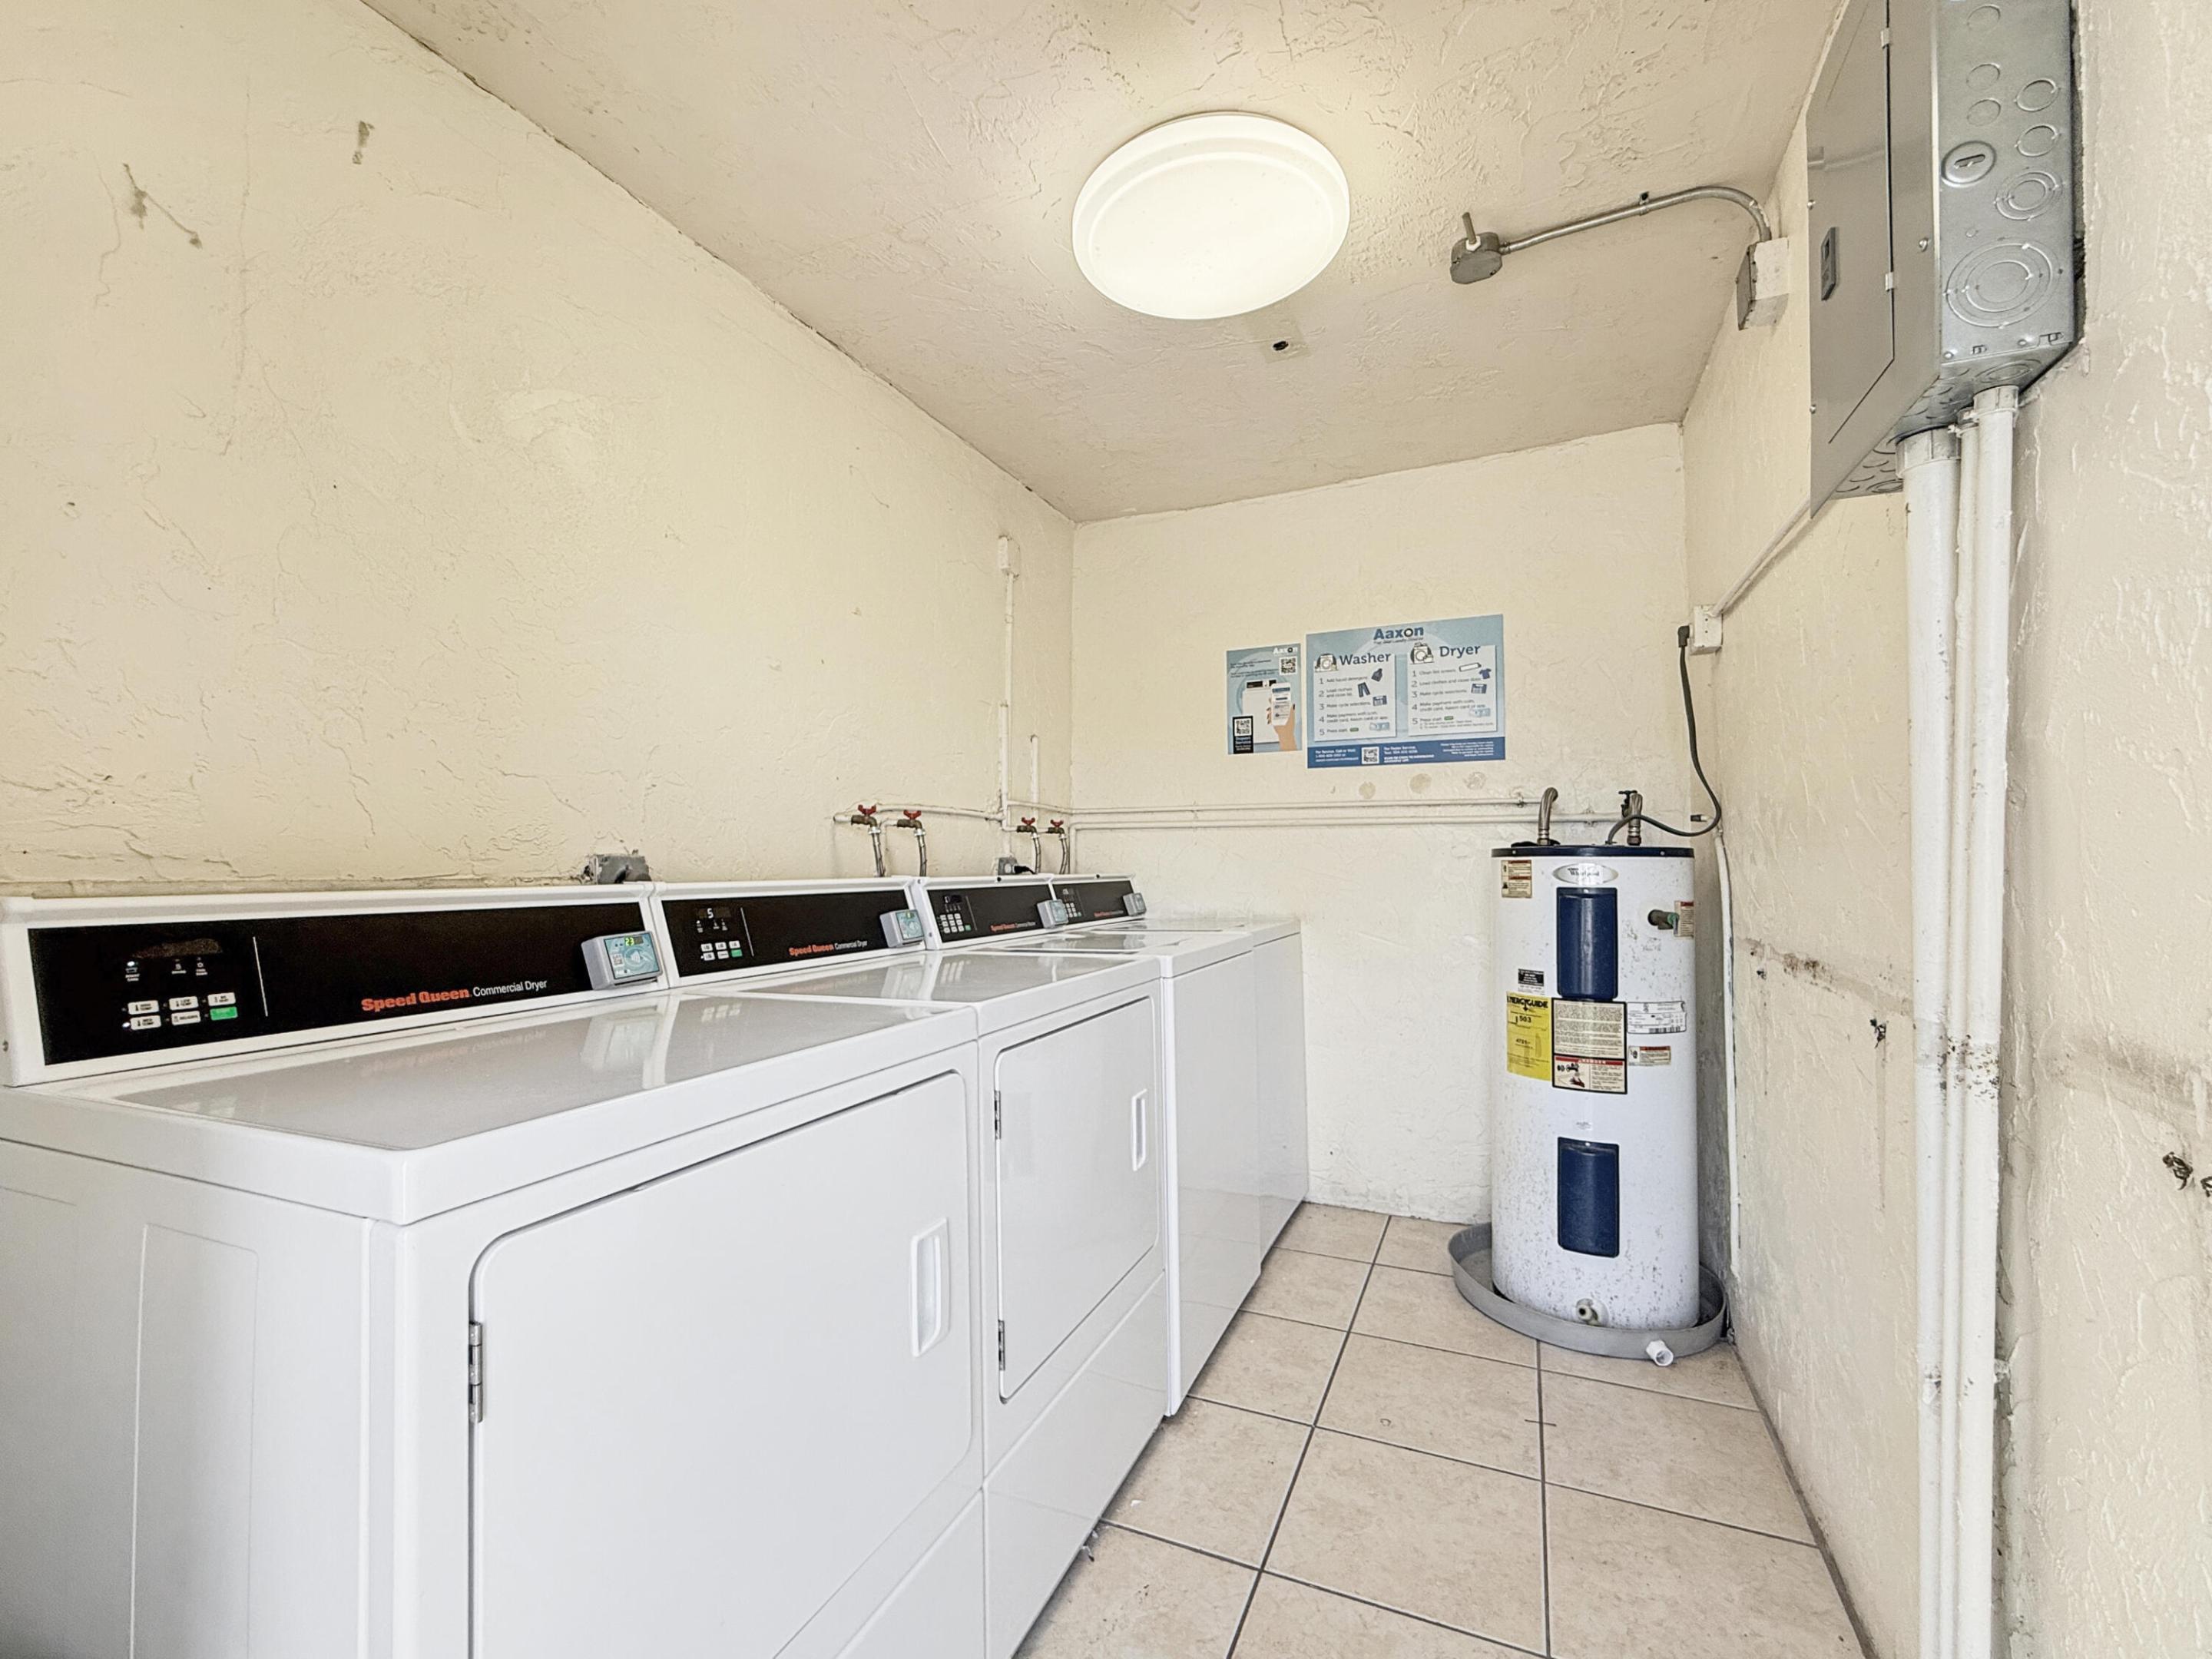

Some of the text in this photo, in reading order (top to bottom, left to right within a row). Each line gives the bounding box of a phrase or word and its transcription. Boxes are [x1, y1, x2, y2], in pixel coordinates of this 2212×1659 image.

[1373, 627, 1424, 640] Aaxon
[1439, 645, 1481, 659] Dryer
[1339, 652, 1391, 666] Washer
[624, 937, 634, 946] 23
[789, 945, 812, 956] Speed
[812, 944, 834, 952] Queen
[361, 980, 548, 1012] Speed Queen Commercial Dryer
